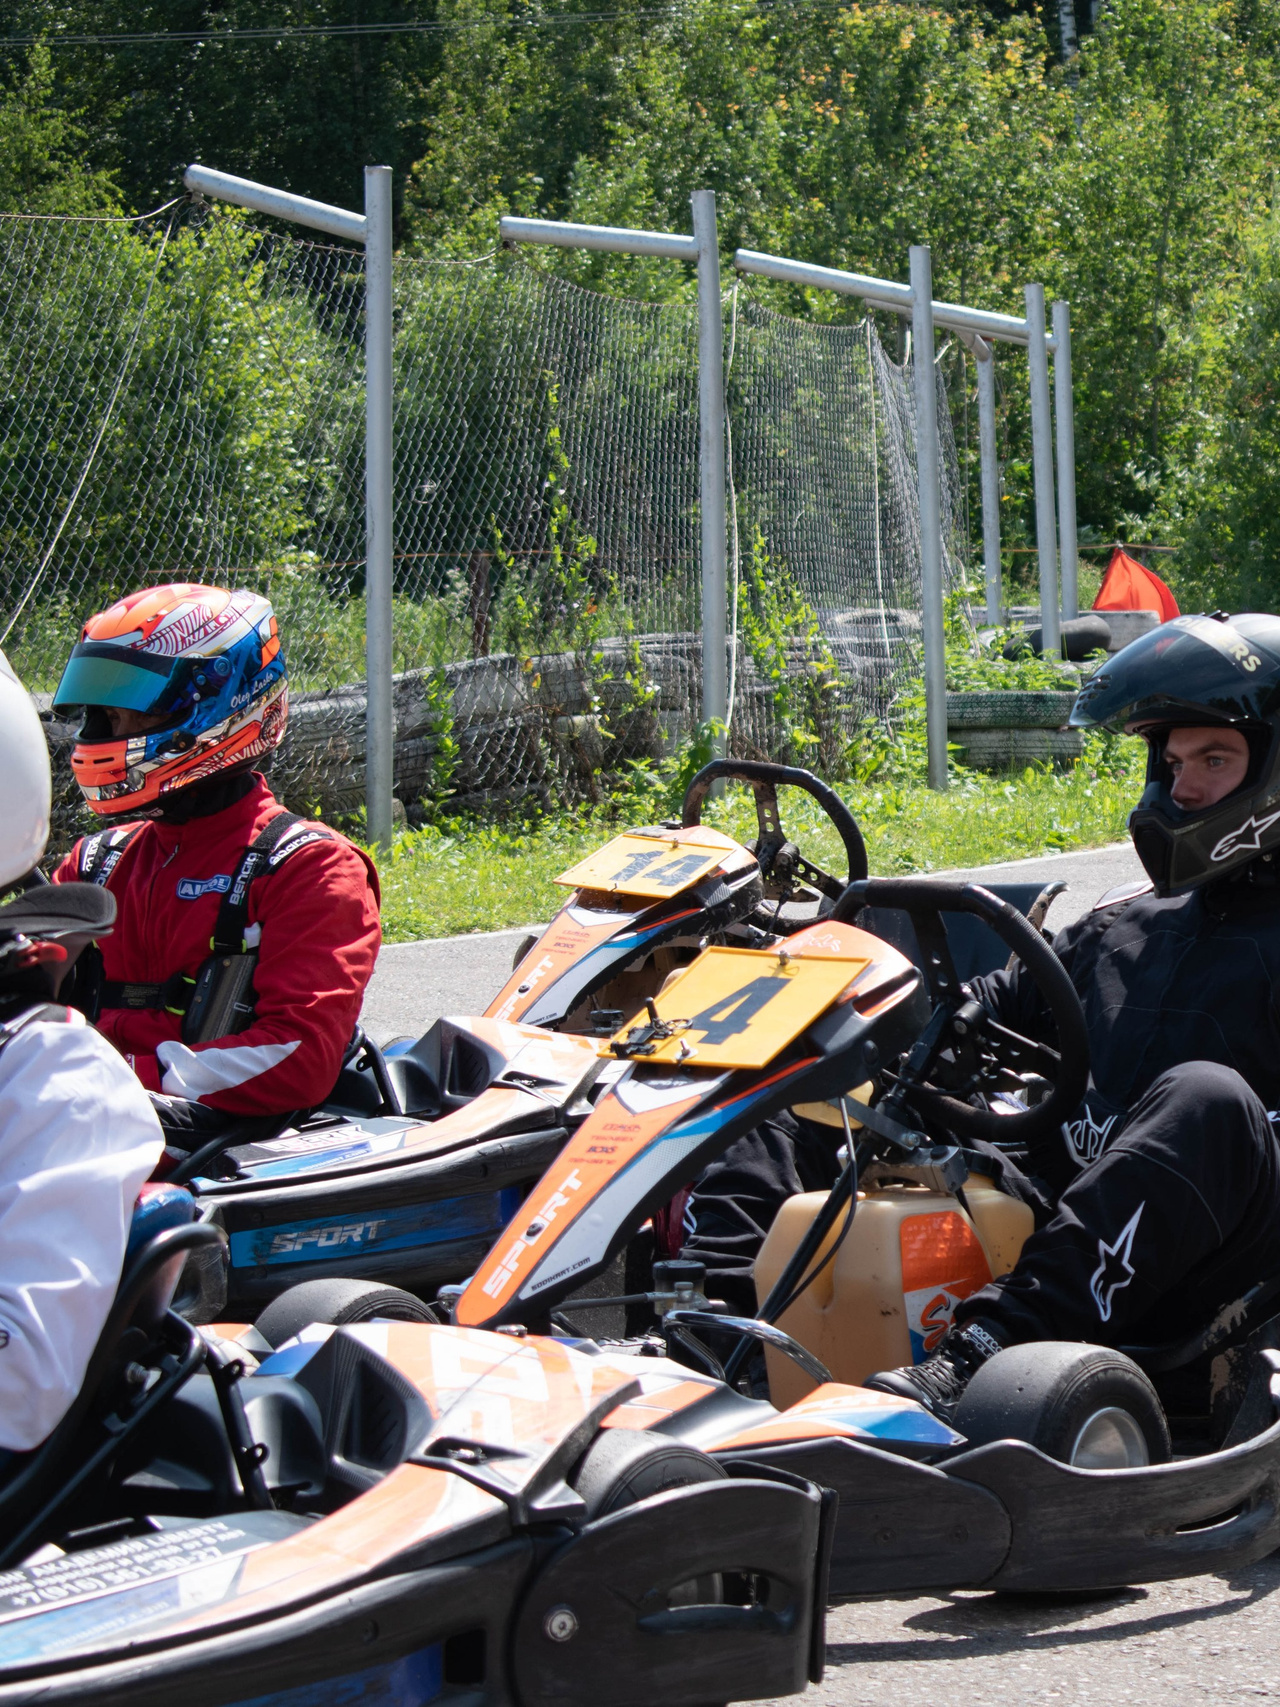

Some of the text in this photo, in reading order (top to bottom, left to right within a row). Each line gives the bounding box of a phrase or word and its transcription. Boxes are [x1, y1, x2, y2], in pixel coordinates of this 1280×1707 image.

[230, 692, 250, 708] Oleg
[269, 832, 321, 866] sparco
[610, 850, 712, 888] 14
[690, 976, 792, 1046] 4
[270, 1219, 387, 1254] SPORT
[482, 1168, 583, 1299] SPORT
[969, 1323, 1003, 1353] sparco
[31, 1521, 228, 1576] АКАДЕМИЯ LIBERTY
